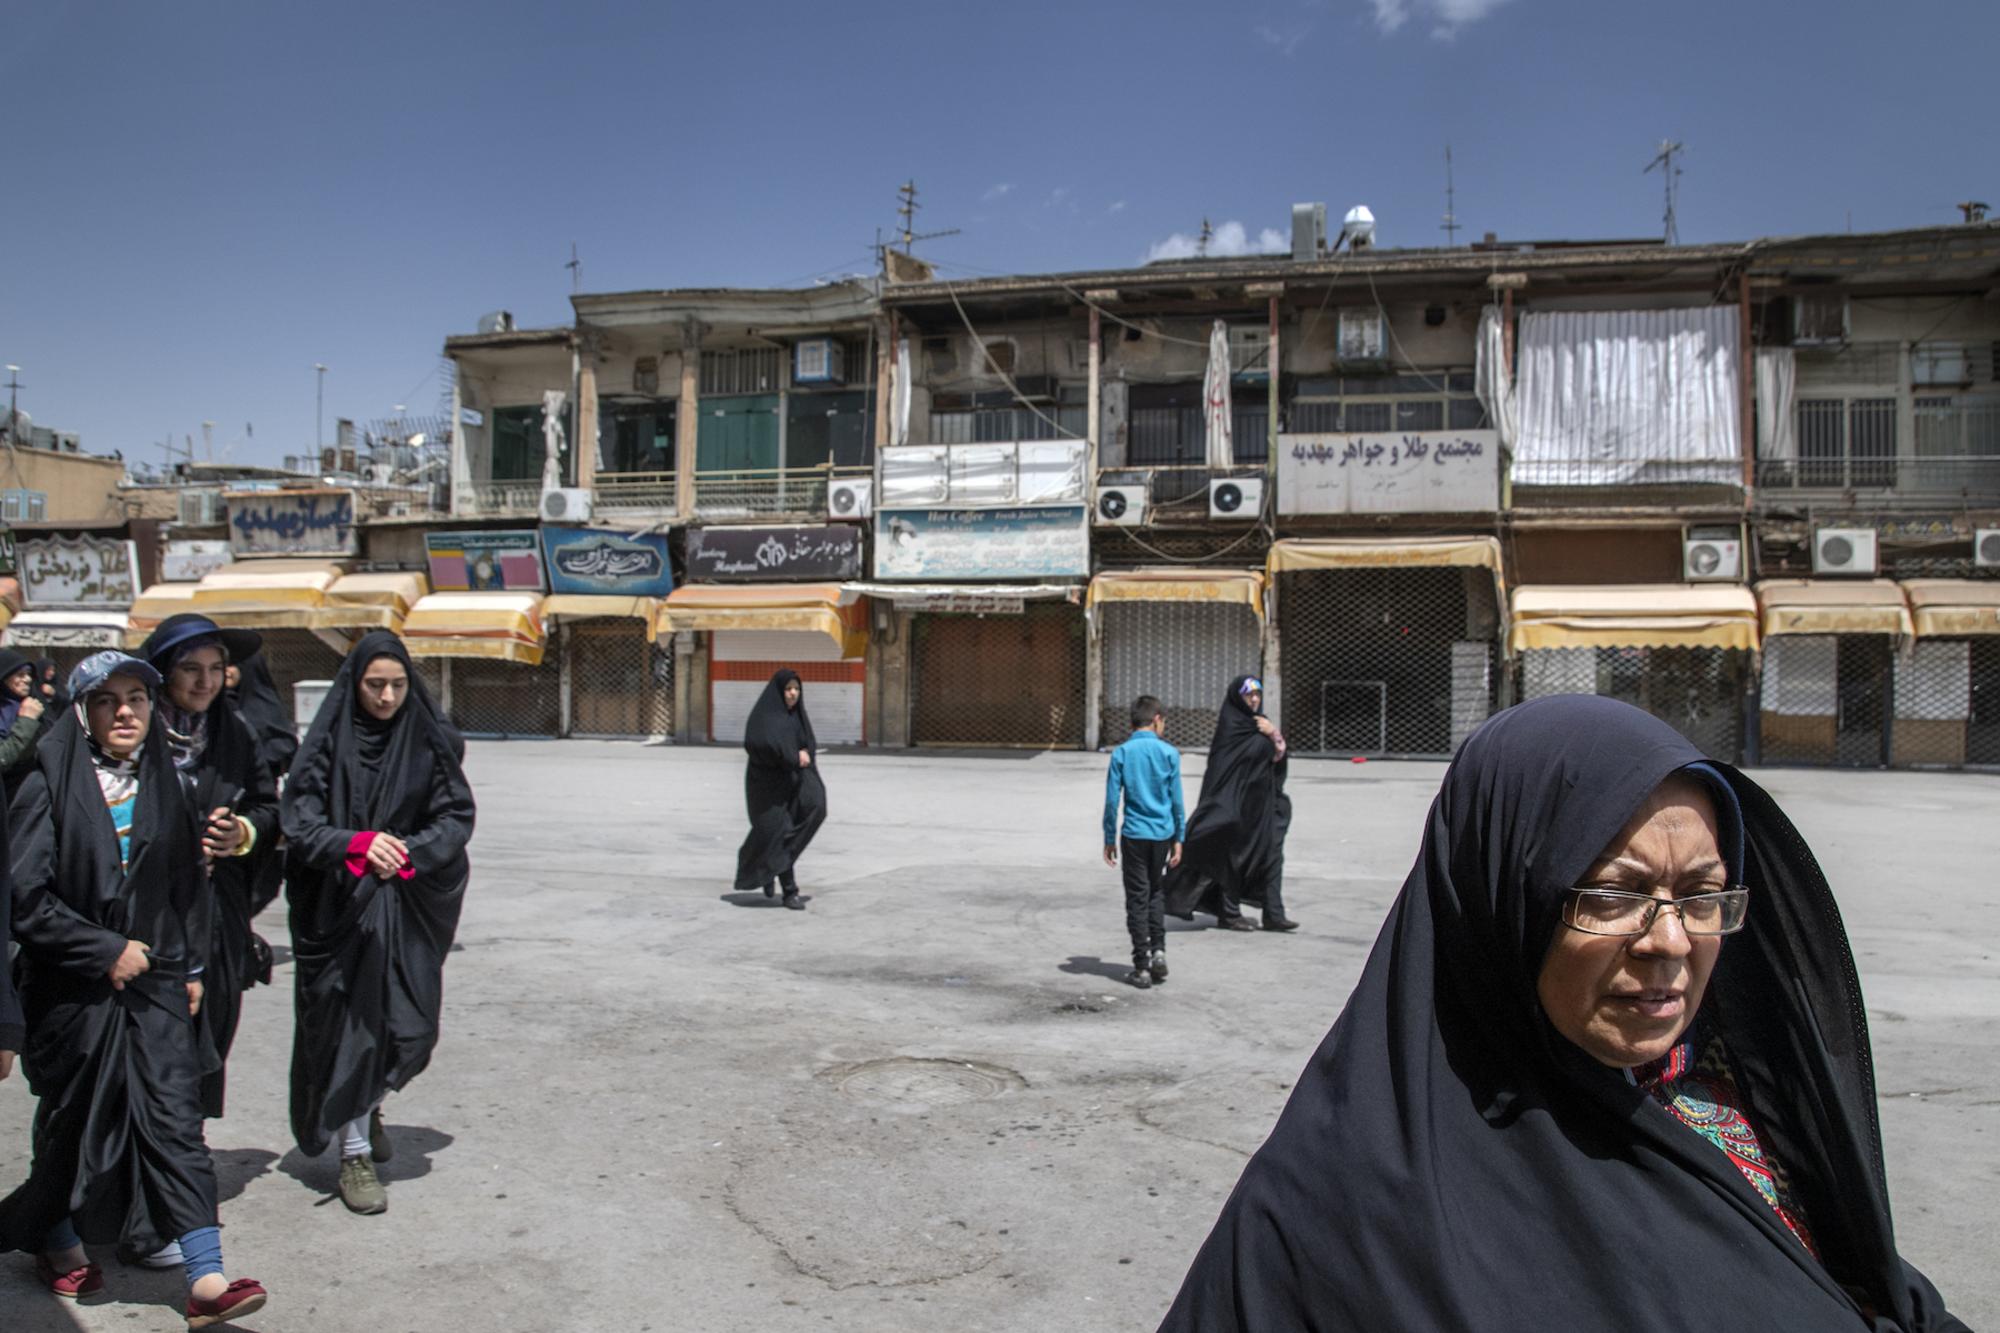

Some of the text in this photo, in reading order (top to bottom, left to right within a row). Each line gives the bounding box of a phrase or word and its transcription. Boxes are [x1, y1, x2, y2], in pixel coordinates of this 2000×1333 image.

[1291, 435, 1483, 466] مجتمع طلا و جواهر مهدیه
[928, 510, 985, 524] Hot Coffee
[99, 548, 129, 574] طلا
[713, 559, 758, 573] Haghani
